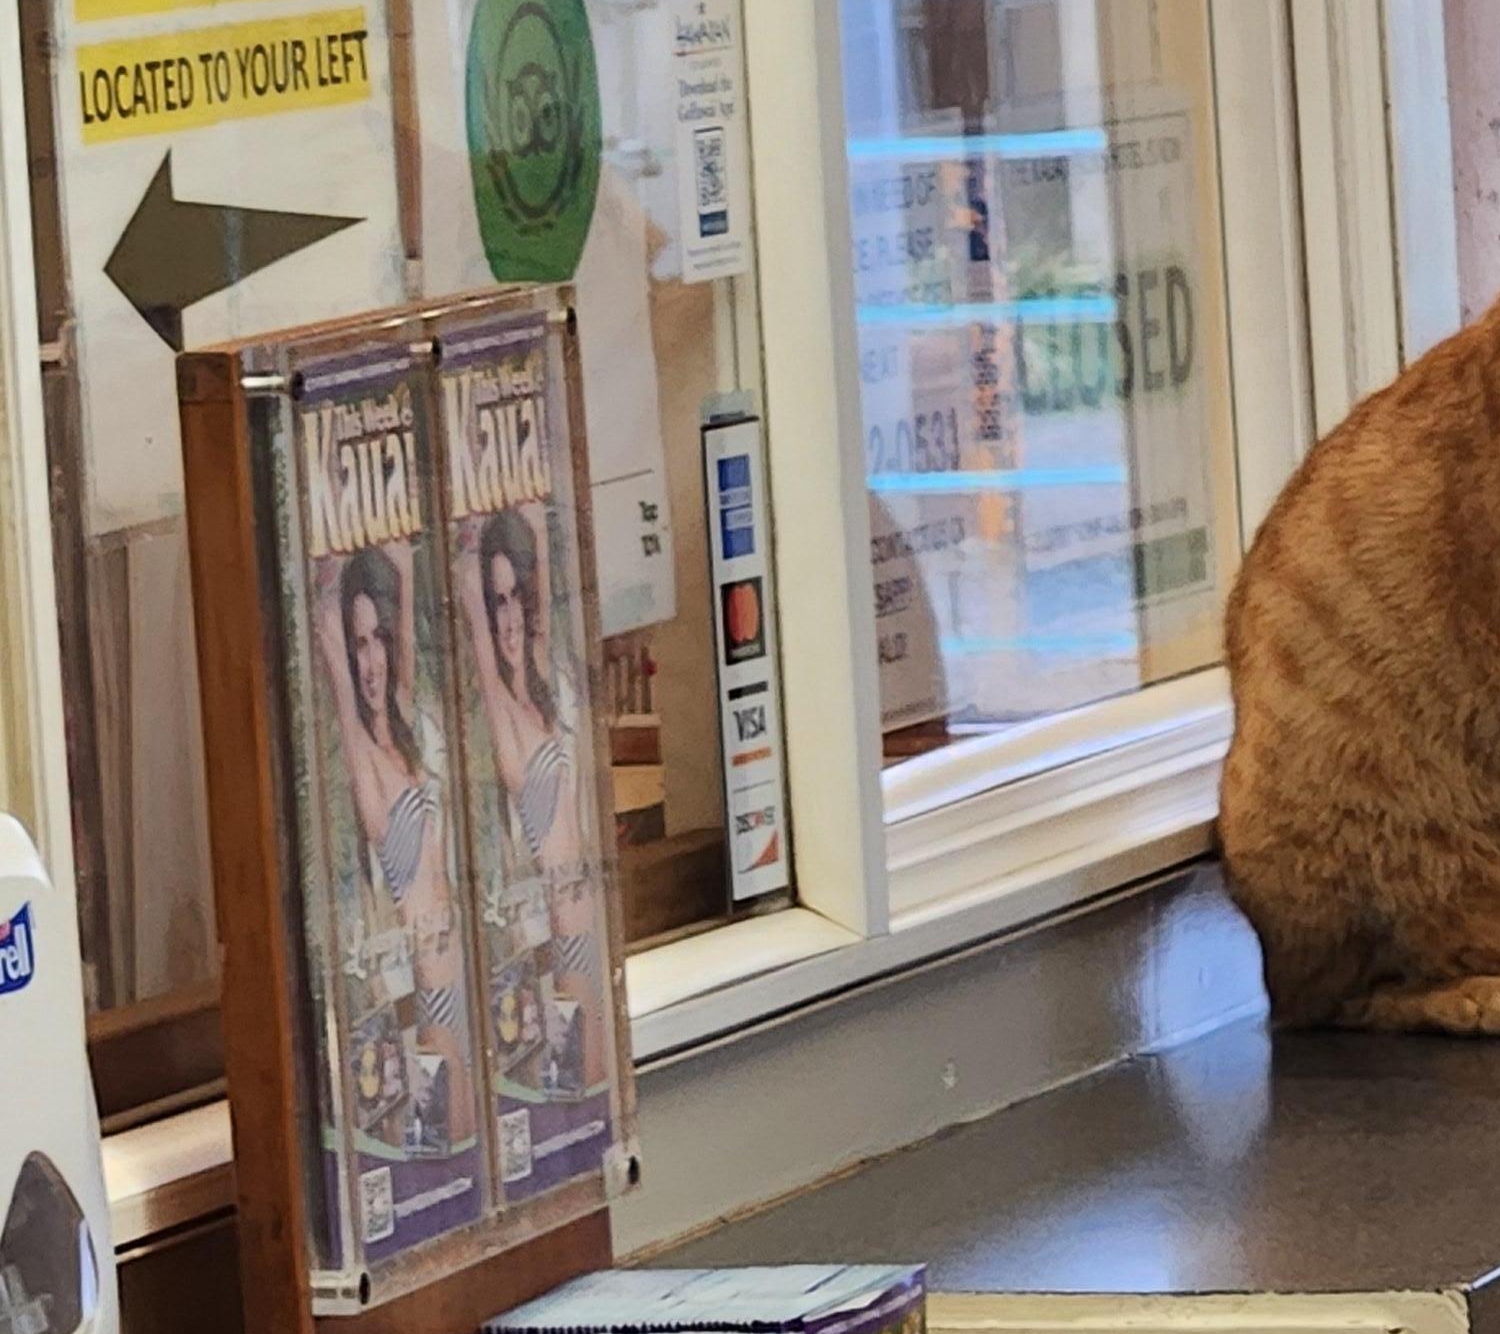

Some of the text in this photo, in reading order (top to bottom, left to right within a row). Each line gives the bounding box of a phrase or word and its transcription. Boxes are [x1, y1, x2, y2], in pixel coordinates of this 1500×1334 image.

[80, 30, 368, 125] LOCATED TO YOUR LEFT
[1012, 267, 1194, 415] CLOSED
[301, 404, 422, 559] Kauai
[733, 708, 769, 744] VISA
